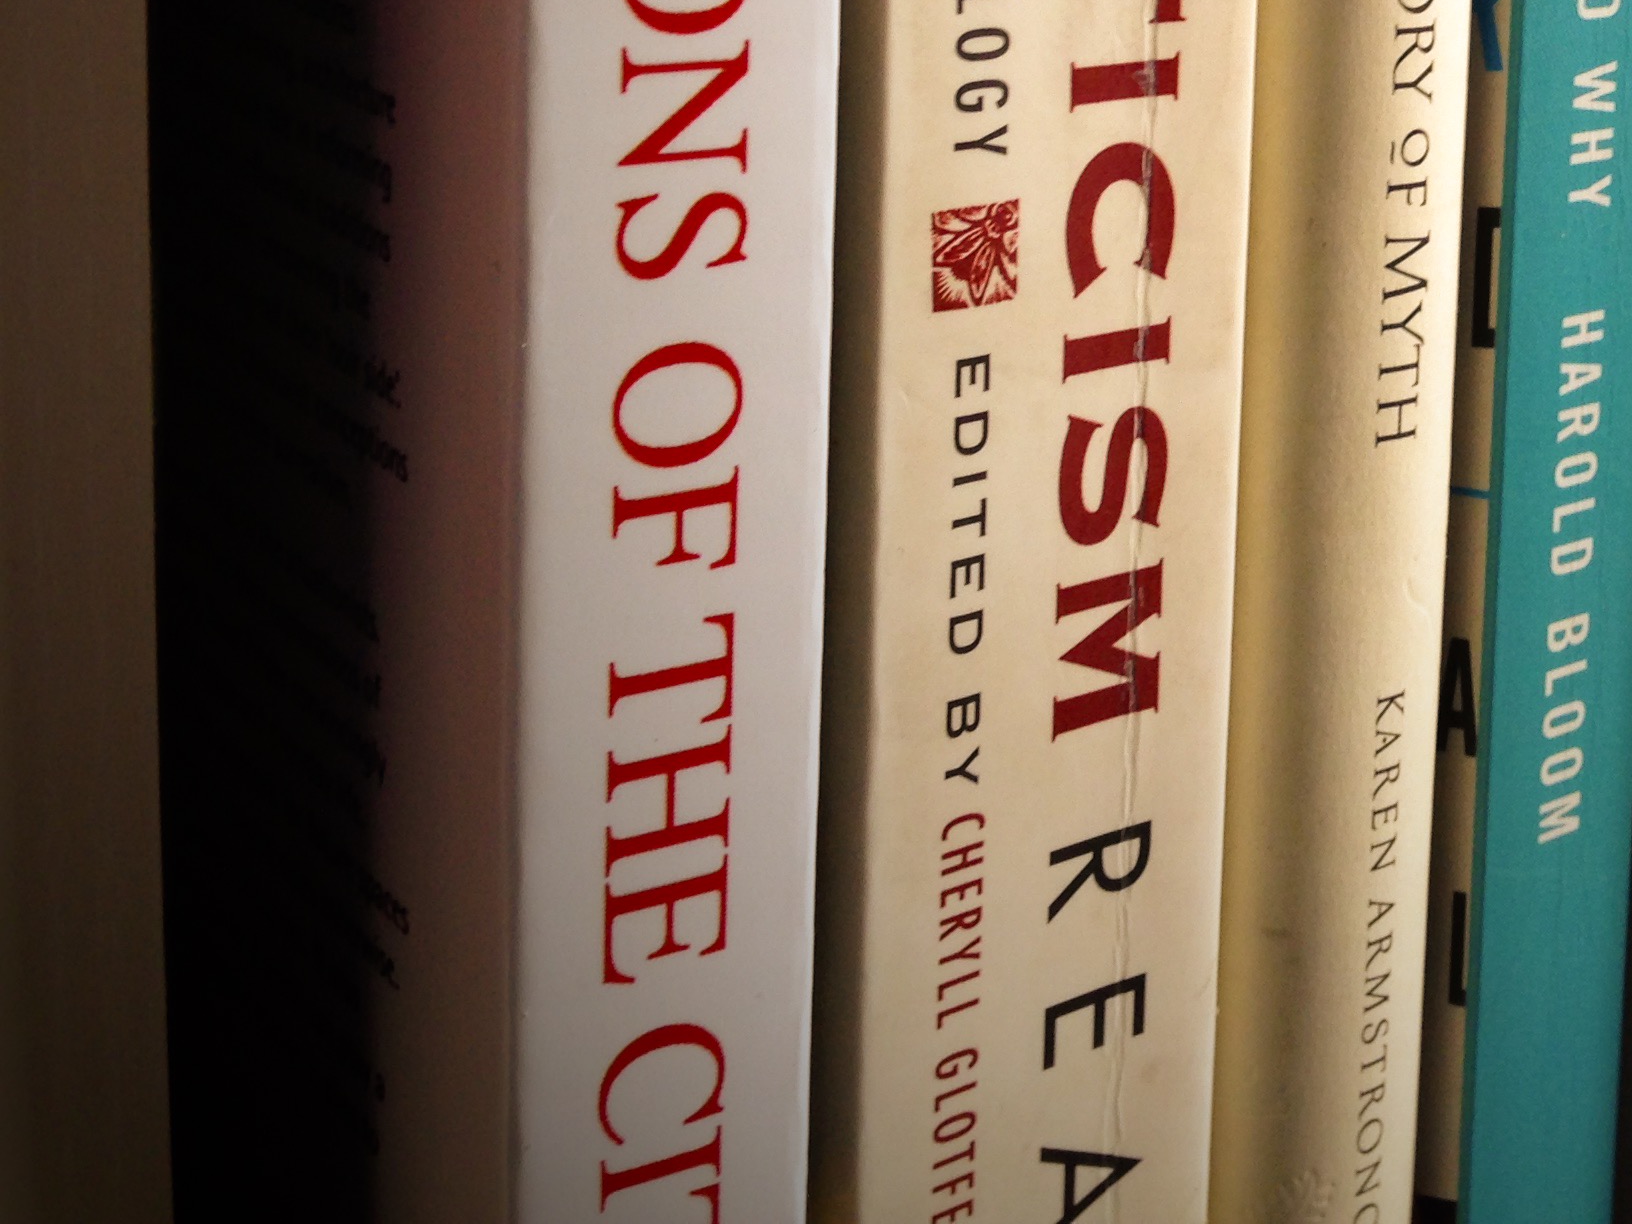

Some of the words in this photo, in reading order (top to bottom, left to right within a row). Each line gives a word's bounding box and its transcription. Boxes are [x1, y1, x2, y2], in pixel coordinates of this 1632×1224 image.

[1386, 129, 1431, 208] OF
[1568, 61, 1618, 208] WHY
[1375, 230, 1431, 448] MYTH
[1551, 309, 1606, 576] HAROLD
[612, 341, 745, 571] OF
[947, 353, 991, 656] EDITED
[603, 613, 736, 985] THE
[943, 693, 982, 785] BY
[1369, 689, 1406, 873] KAREN
[1538, 612, 1591, 845] BLOOM
[937, 812, 986, 1030] CHERYLL
